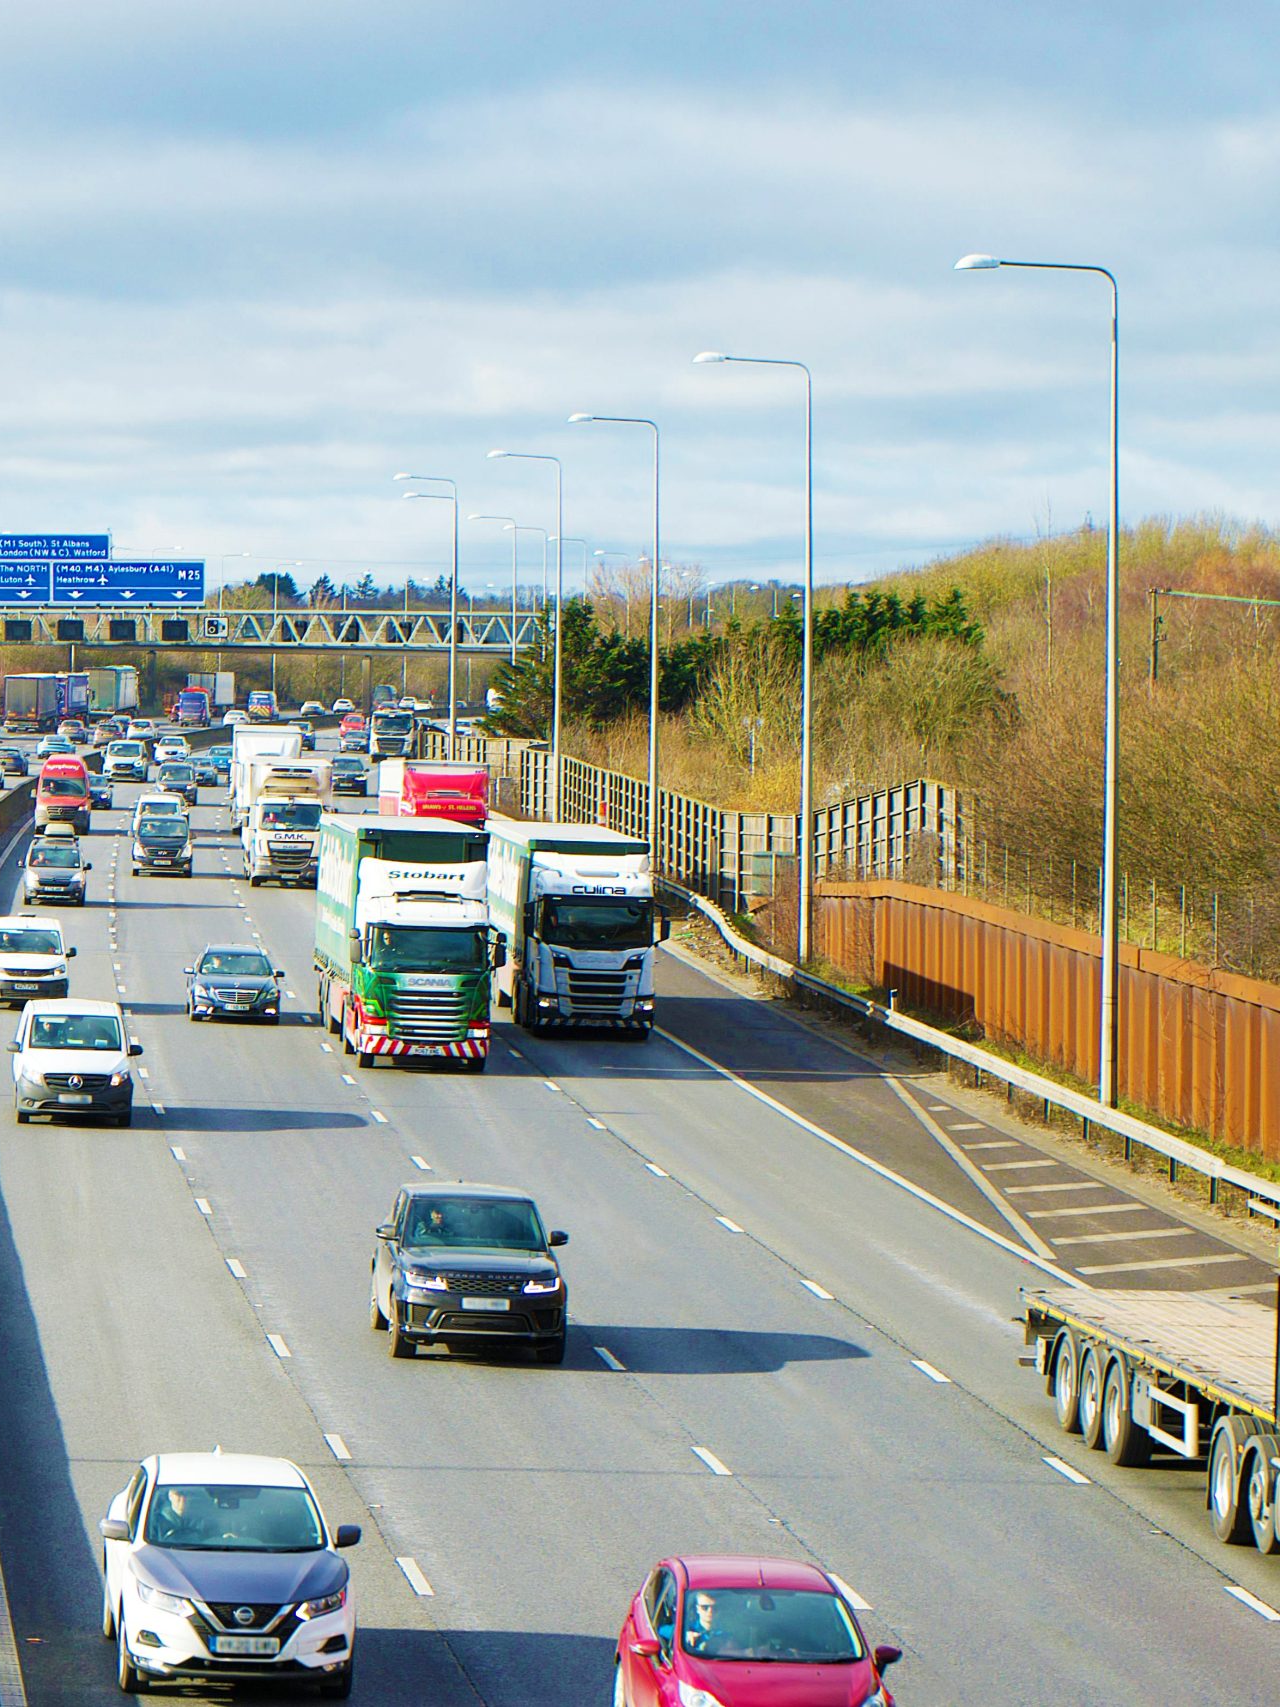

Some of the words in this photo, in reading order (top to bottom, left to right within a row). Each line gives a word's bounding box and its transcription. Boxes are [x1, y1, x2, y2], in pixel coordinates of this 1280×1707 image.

[51, 540, 60, 548] St
[62, 540, 90, 548] Albans
[107, 565, 147, 574] Aylesbury
[388, 870, 465, 881] Stobart
[572, 885, 627, 895] culina
[407, 978, 452, 987] SCANIA
